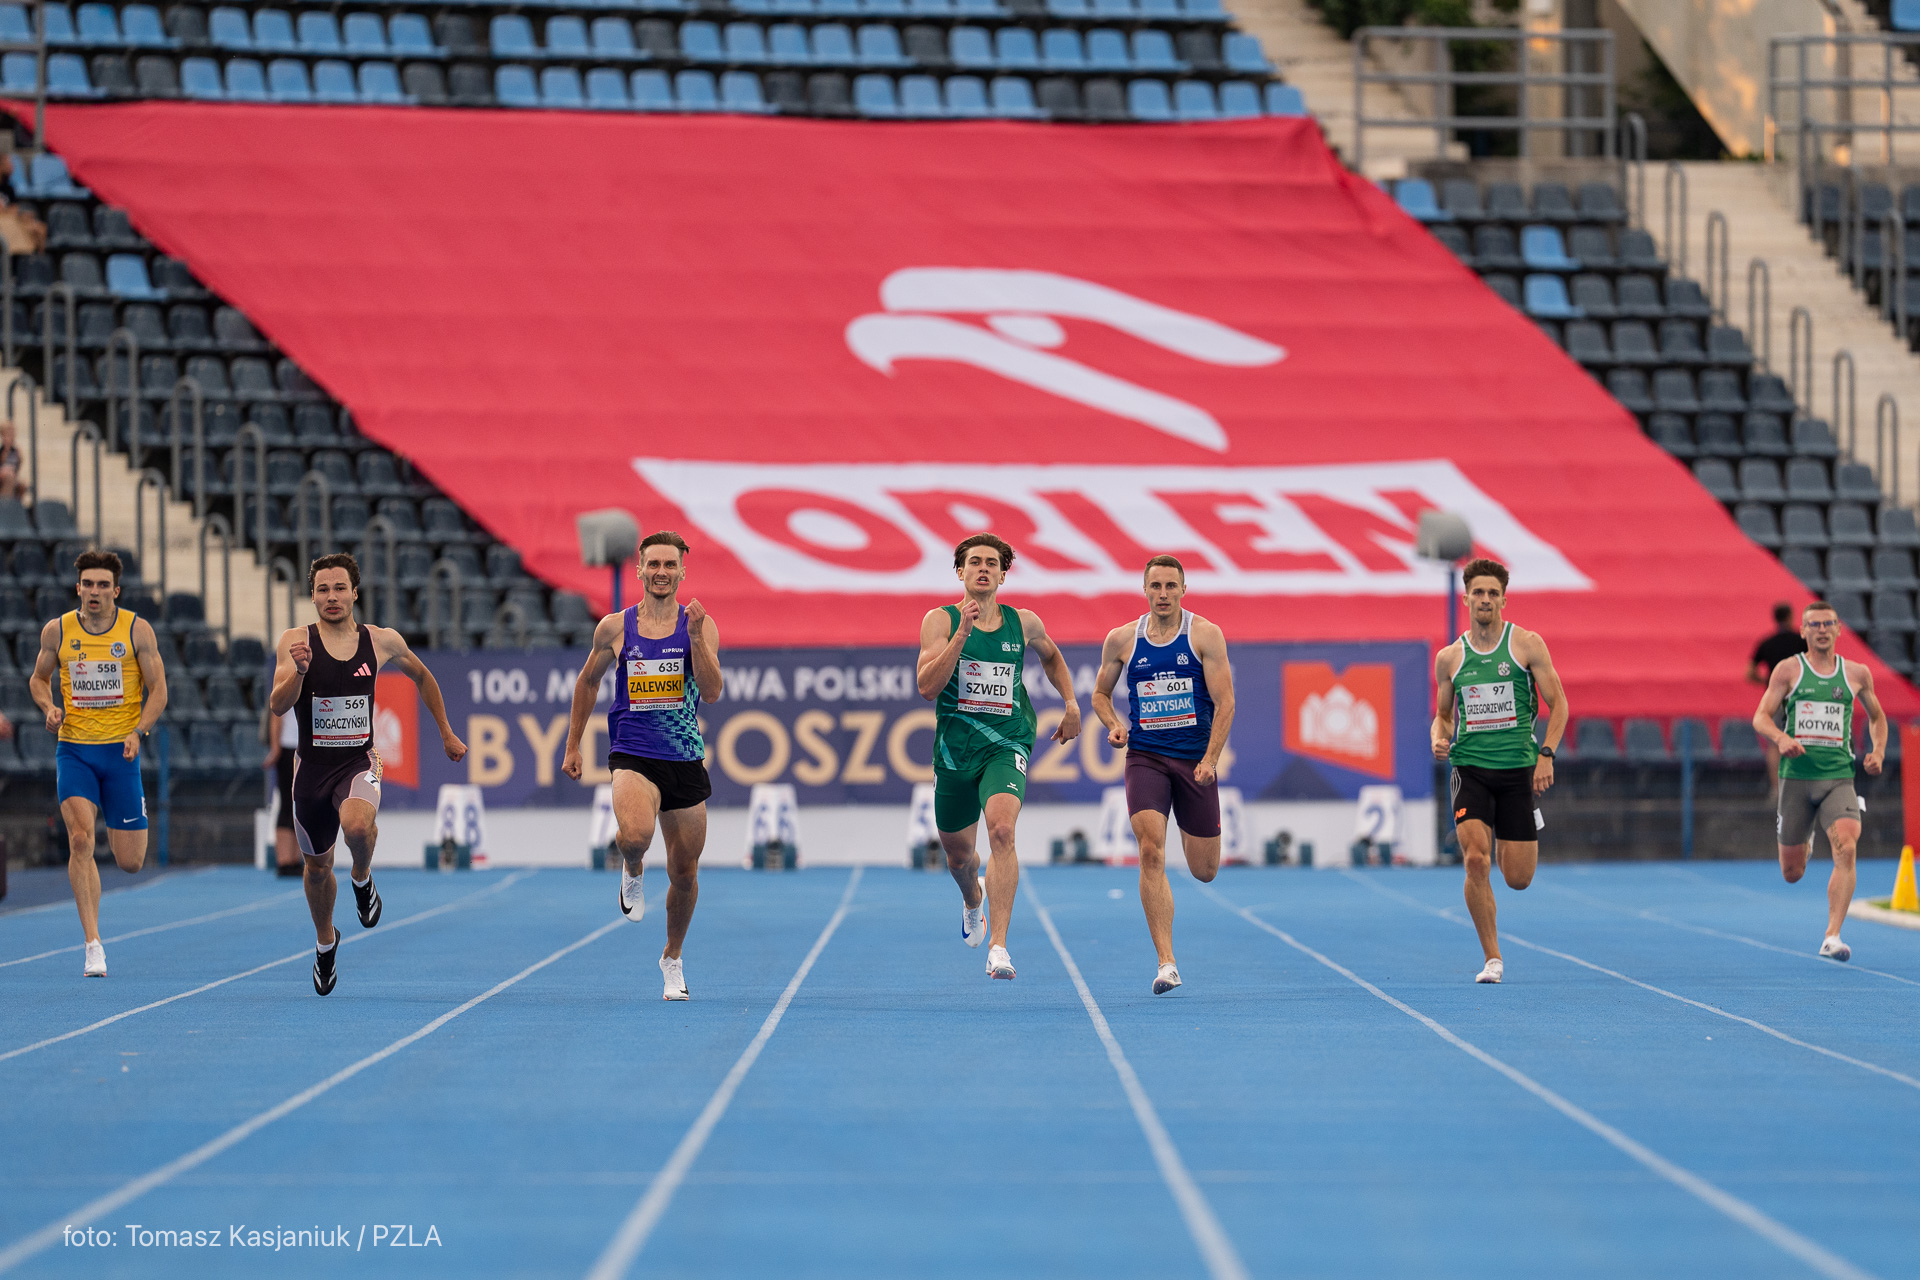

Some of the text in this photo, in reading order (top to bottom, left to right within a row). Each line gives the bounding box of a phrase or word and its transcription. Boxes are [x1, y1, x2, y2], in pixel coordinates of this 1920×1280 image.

[735, 486, 1508, 573] ORLEN
[97, 664, 117, 673] 558
[658, 662, 680, 673] 635
[992, 666, 1011, 677] 174
[72, 680, 121, 691] KAROLEWSKI
[468, 667, 539, 702] 100.
[794, 665, 914, 701] POLSKI
[630, 680, 682, 693] ZALEWSKI
[966, 682, 1007, 697] SZWED
[1166, 681, 1188, 692] 601
[1492, 685, 1505, 695] 97
[345, 698, 365, 710] 569
[1141, 697, 1192, 713] SOŁTYSIAK
[1466, 700, 1513, 715] GRZEGORZEWICZ
[1825, 705, 1840, 715] 104
[314, 715, 368, 730] BOGACZYŃSKI
[1798, 720, 1840, 732] KOTYRA
[1364, 804, 1385, 840] 2
